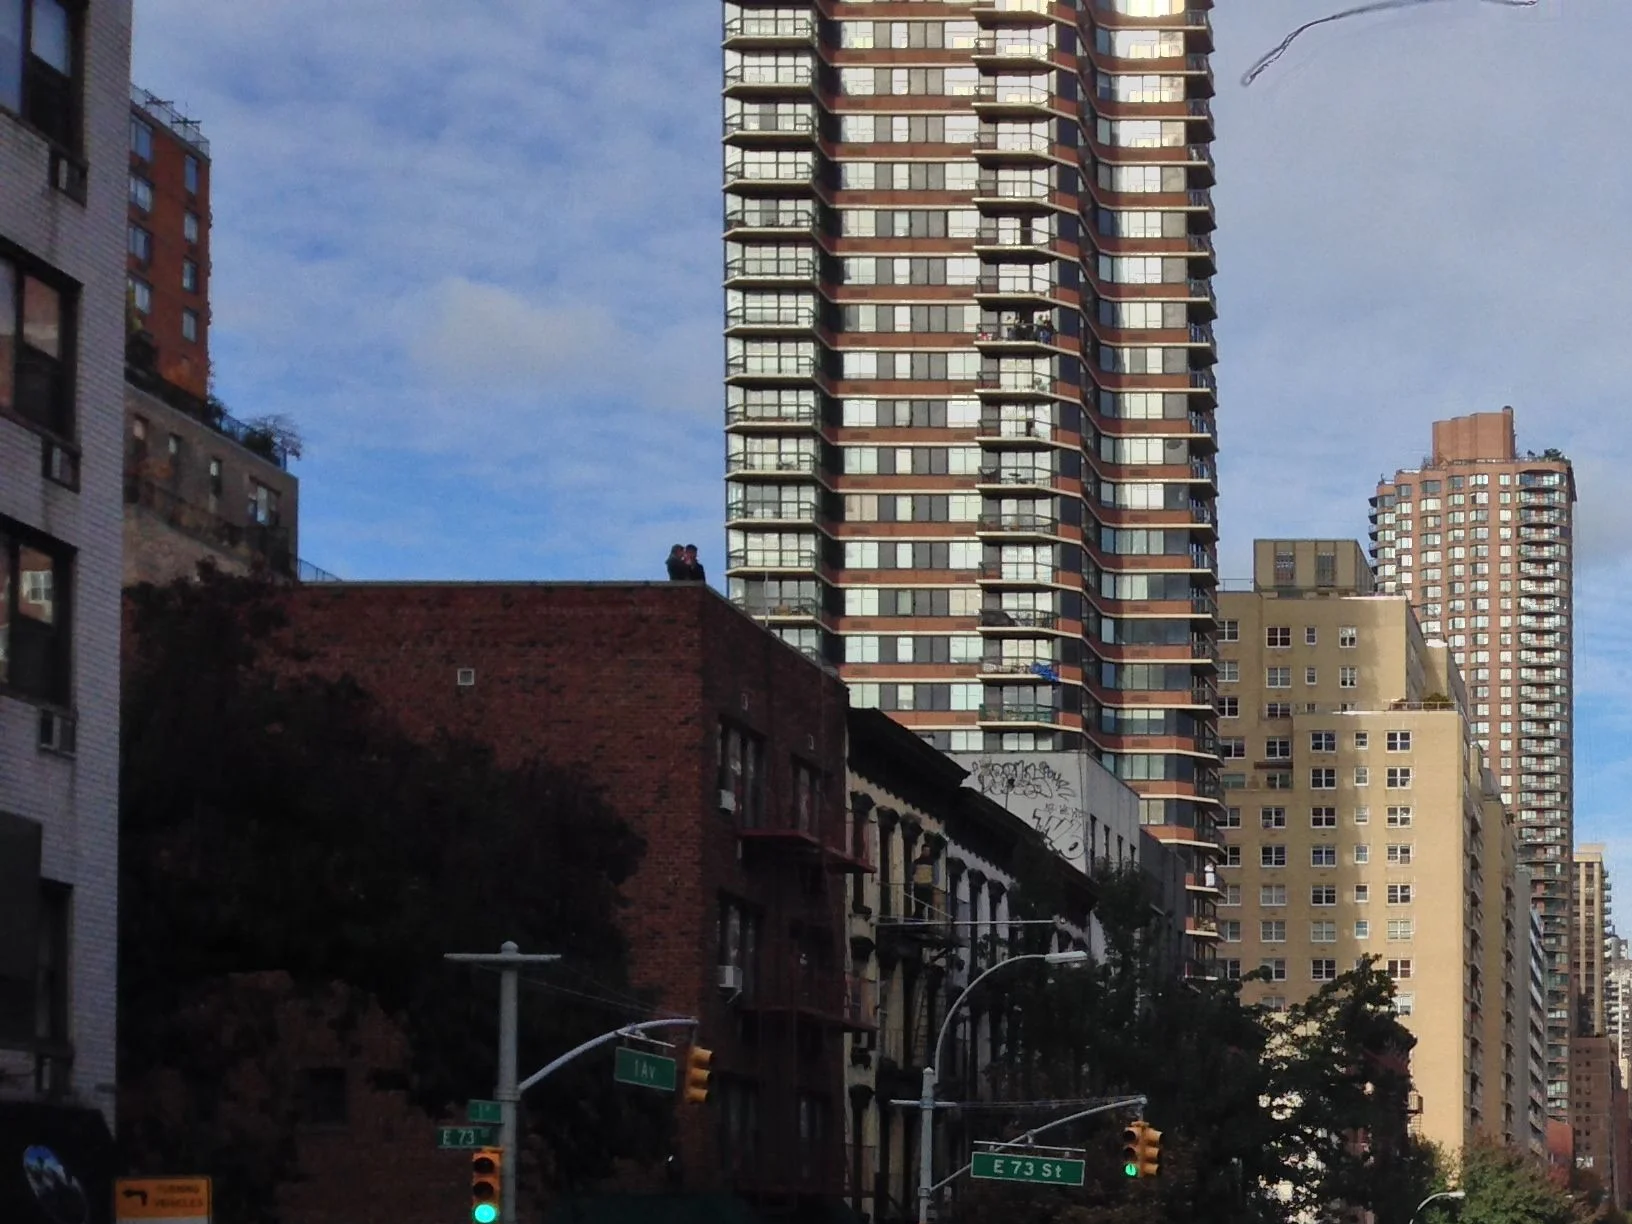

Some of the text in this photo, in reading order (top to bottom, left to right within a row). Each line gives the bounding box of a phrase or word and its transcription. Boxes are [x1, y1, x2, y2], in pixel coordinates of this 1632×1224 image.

[443, 1129, 451, 1146] E
[457, 1129, 475, 1146] 73
[993, 1159, 1062, 1178] E 73 St
